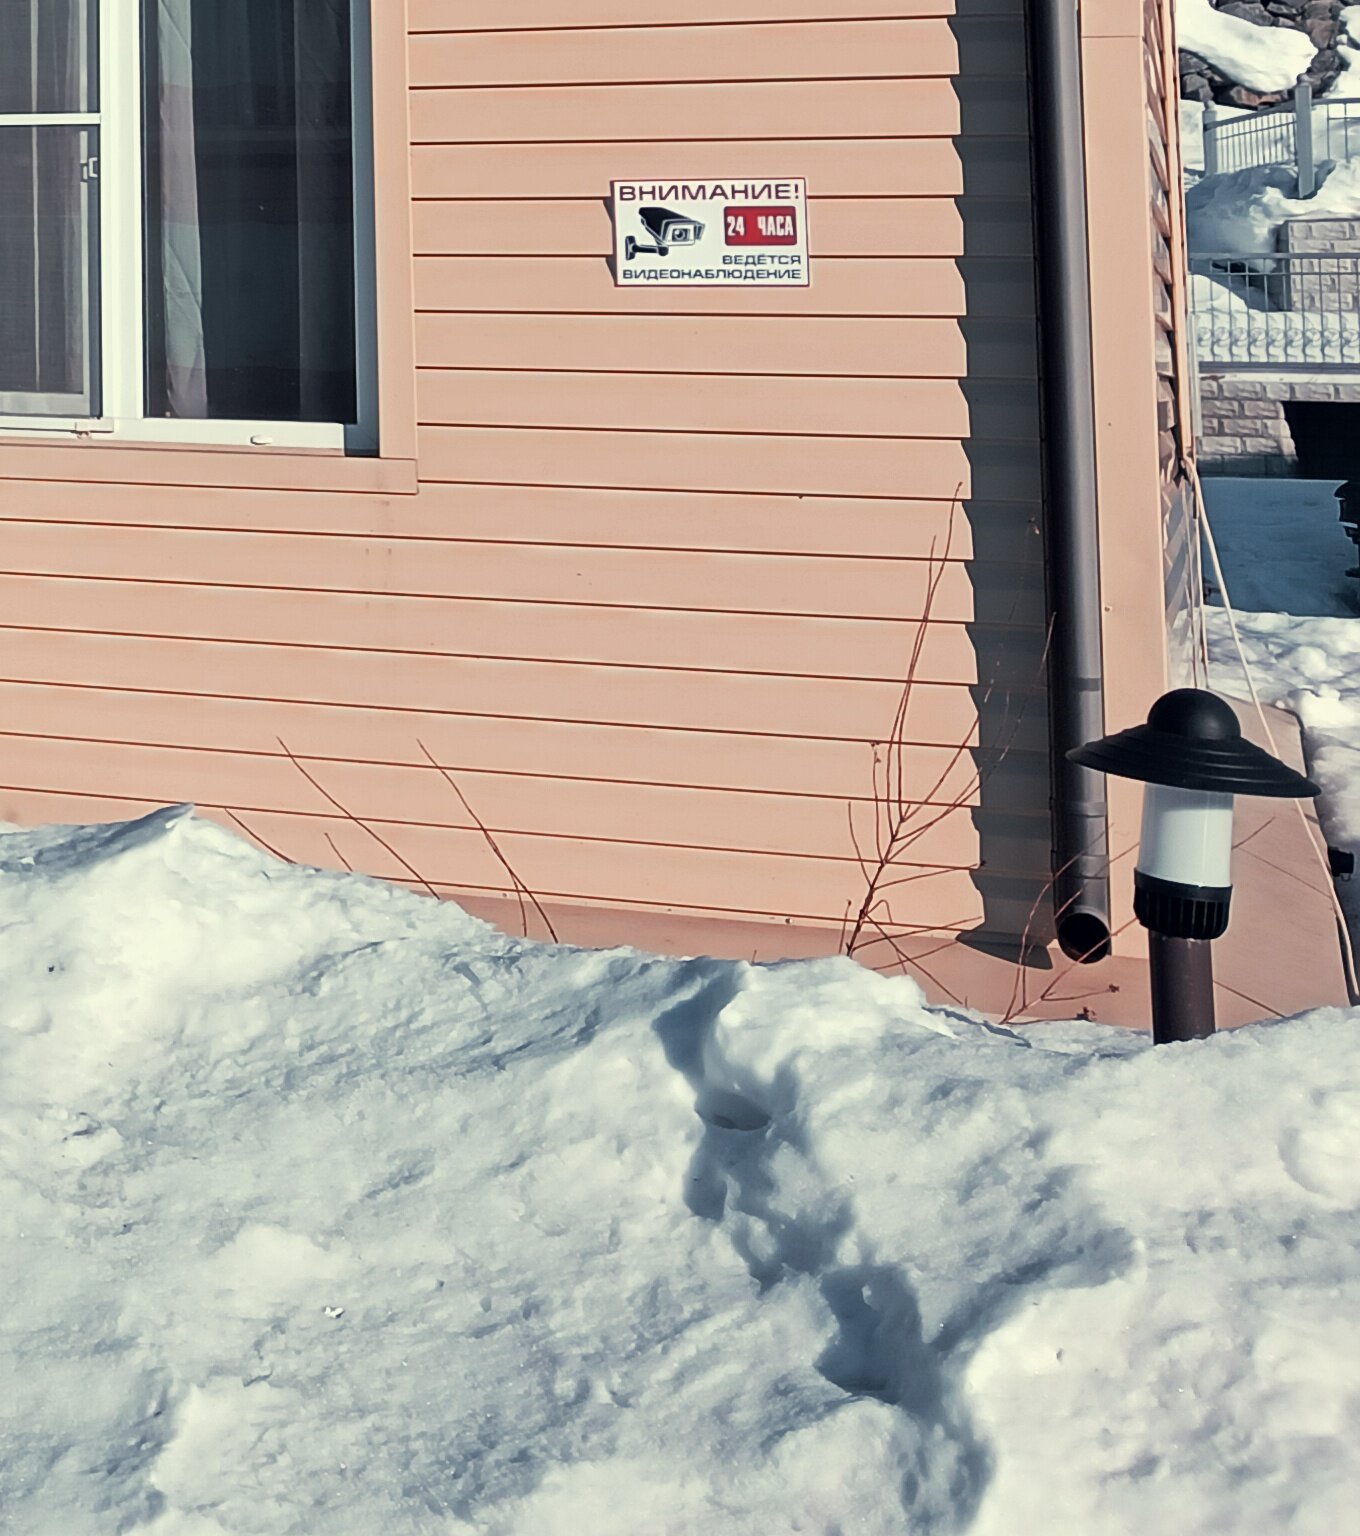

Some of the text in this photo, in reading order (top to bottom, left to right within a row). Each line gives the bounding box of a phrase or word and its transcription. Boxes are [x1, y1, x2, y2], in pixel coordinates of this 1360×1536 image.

[619, 184, 799, 201] ВНИМАНИЕ!
[727, 216, 794, 236] 24 ЧАСА
[622, 269, 801, 280] ВИДЕОНАБЛЮДЕНИЕ
